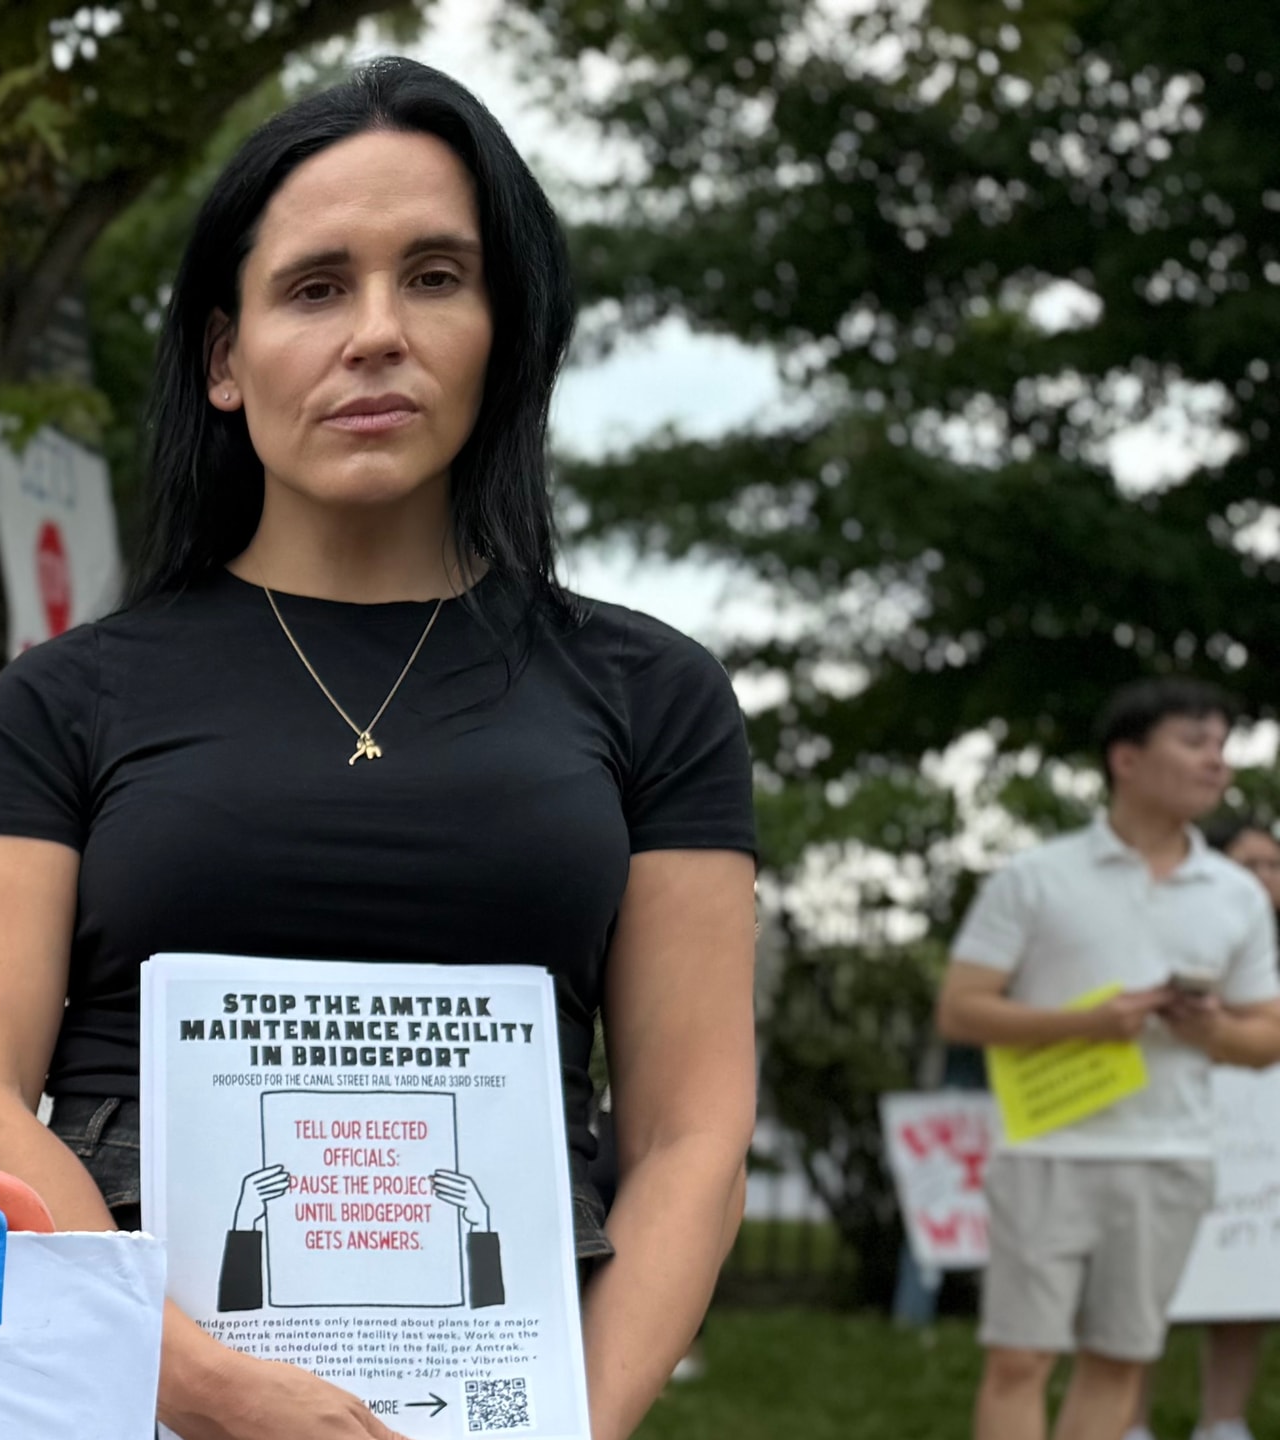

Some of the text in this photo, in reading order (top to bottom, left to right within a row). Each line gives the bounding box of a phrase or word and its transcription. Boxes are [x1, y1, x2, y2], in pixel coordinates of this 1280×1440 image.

[223, 993, 492, 1017] STOP THE AMTRAK
[180, 1020, 534, 1043] MAINTENANCE FACILITY
[250, 1045, 470, 1067] IN BRIDGEPORT
[212, 1074, 506, 1087] PROPOSED FOR THE CANAL STREET RAIL YARD NEAR 33RD STREET
[294, 1120, 428, 1140] TELL OUR ELECTED
[323, 1148, 400, 1167] OFFICIALS:
[289, 1175, 339, 1194] PAUSE
[343, 1175, 369, 1194] THE
[295, 1203, 432, 1223] UNTIL BRIDGEPORT
[305, 1230, 424, 1250] GETS ANSWERS.
[263, 1318, 320, 1327] residents
[324, 1317, 349, 1328] only
[353, 1318, 397, 1327] learned
[401, 1318, 434, 1327] about
[438, 1318, 470, 1329] plans
[473, 1318, 490, 1327] for
[504, 1317, 540, 1329] major
[227, 1332, 271, 1340] Amtrak
[275, 1331, 353, 1340] maintenance
[357, 1331, 398, 1342] facility
[402, 1331, 423, 1340] last
[427, 1331, 461, 1340] week.
[464, 1331, 495, 1340] Work
[499, 1332, 514, 1340] on
[517, 1330, 538, 1339] the
[260, 1343, 270, 1352] is
[275, 1343, 338, 1352] scheduled
[341, 1343, 354, 1352] to
[358, 1344, 385, 1352] start
[389, 1343, 400, 1352] in
[403, 1343, 422, 1352] the
[426, 1343, 448, 1354] fall,
[451, 1345, 471, 1355] per
[475, 1343, 524, 1352] Amtrak.
[316, 1355, 353, 1364] Diesel
[356, 1356, 414, 1365] emissions
[426, 1356, 458, 1365] Noise
[471, 1355, 528, 1365] Vibration
[359, 1368, 403, 1379] lighting
[414, 1368, 441, 1378] 24/7
[445, 1368, 492, 1379] activity
[368, 1400, 399, 1415] MORE
